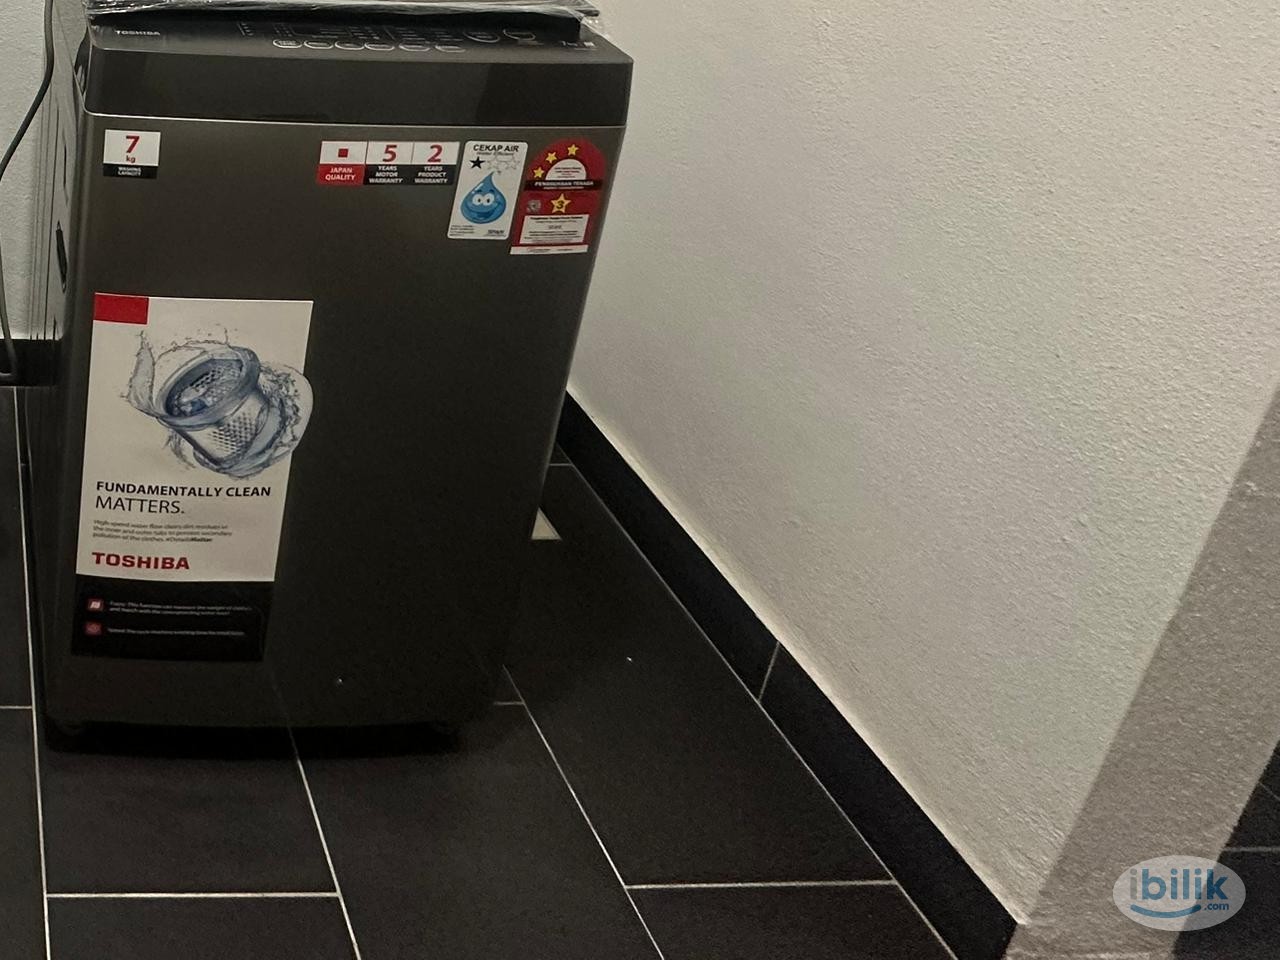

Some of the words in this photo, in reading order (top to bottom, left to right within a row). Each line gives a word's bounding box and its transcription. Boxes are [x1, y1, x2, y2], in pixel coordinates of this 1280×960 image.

[126, 135, 140, 153] 7
[382, 144, 398, 162] 5
[427, 144, 443, 162] 2
[473, 144, 503, 152] CEKAP
[503, 145, 520, 153] AIR
[126, 155, 136, 163] kg
[556, 200, 565, 209] 3
[96, 481, 222, 497] FUNDAMENTALLY
[225, 487, 271, 497] CLEAN
[95, 495, 185, 514] MATTERS.
[92, 552, 190, 570] TOSHIBA
